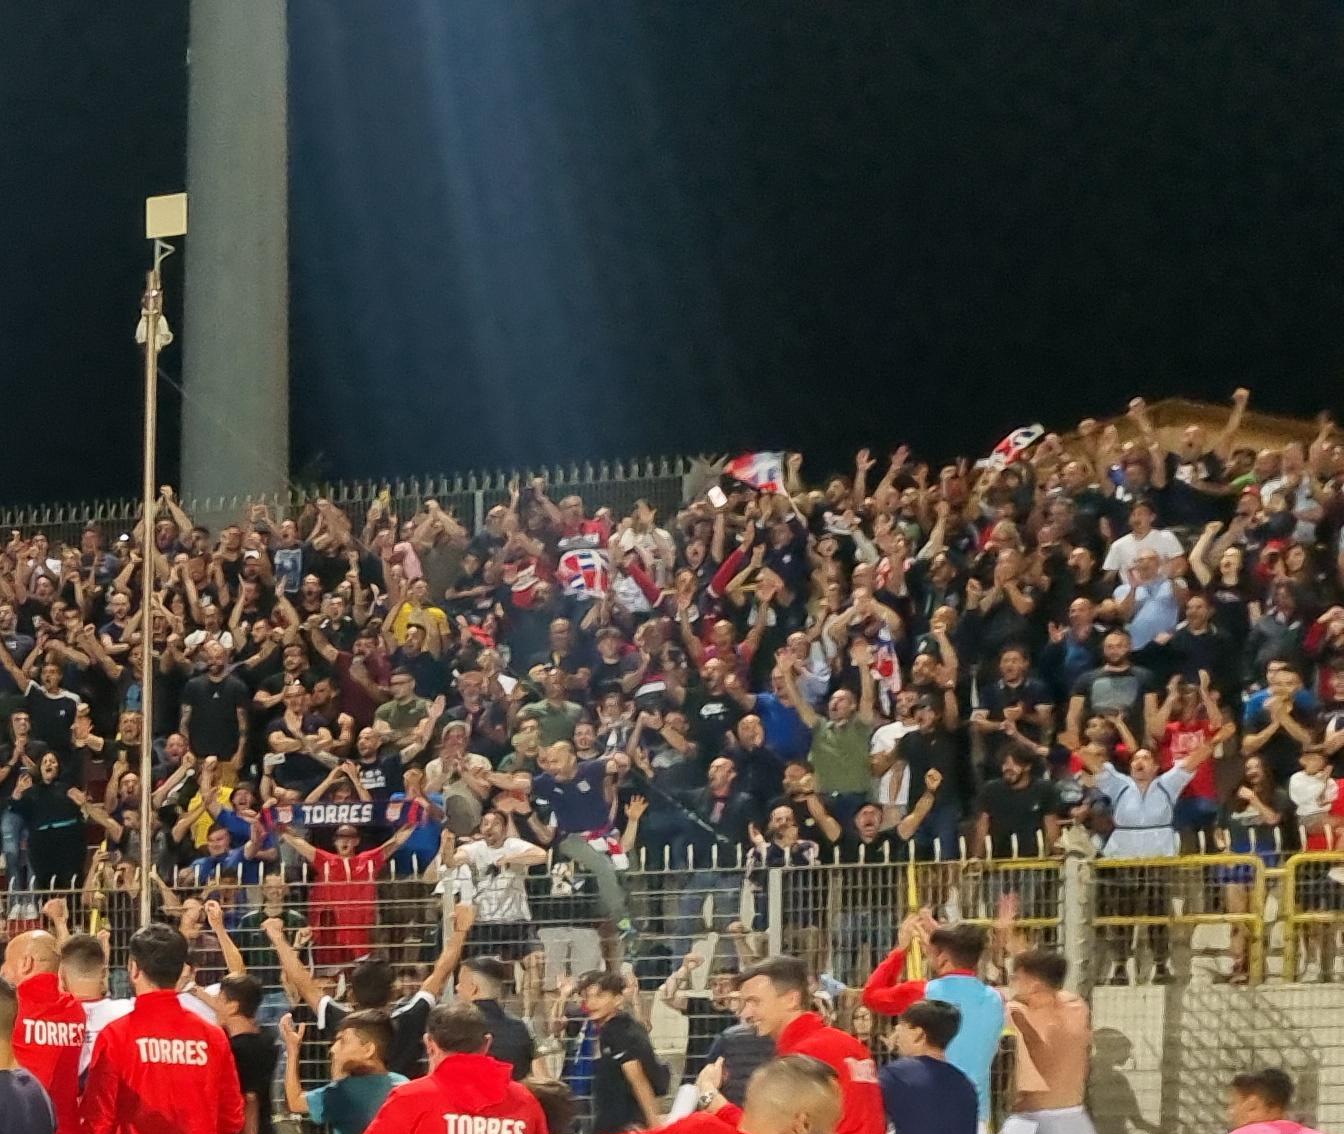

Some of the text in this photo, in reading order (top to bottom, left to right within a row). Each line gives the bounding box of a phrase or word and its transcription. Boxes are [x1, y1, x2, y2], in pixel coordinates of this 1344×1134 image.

[301, 803, 373, 824] TORRES
[23, 1018, 85, 1047] TORRES
[135, 1037, 209, 1066] TORRES
